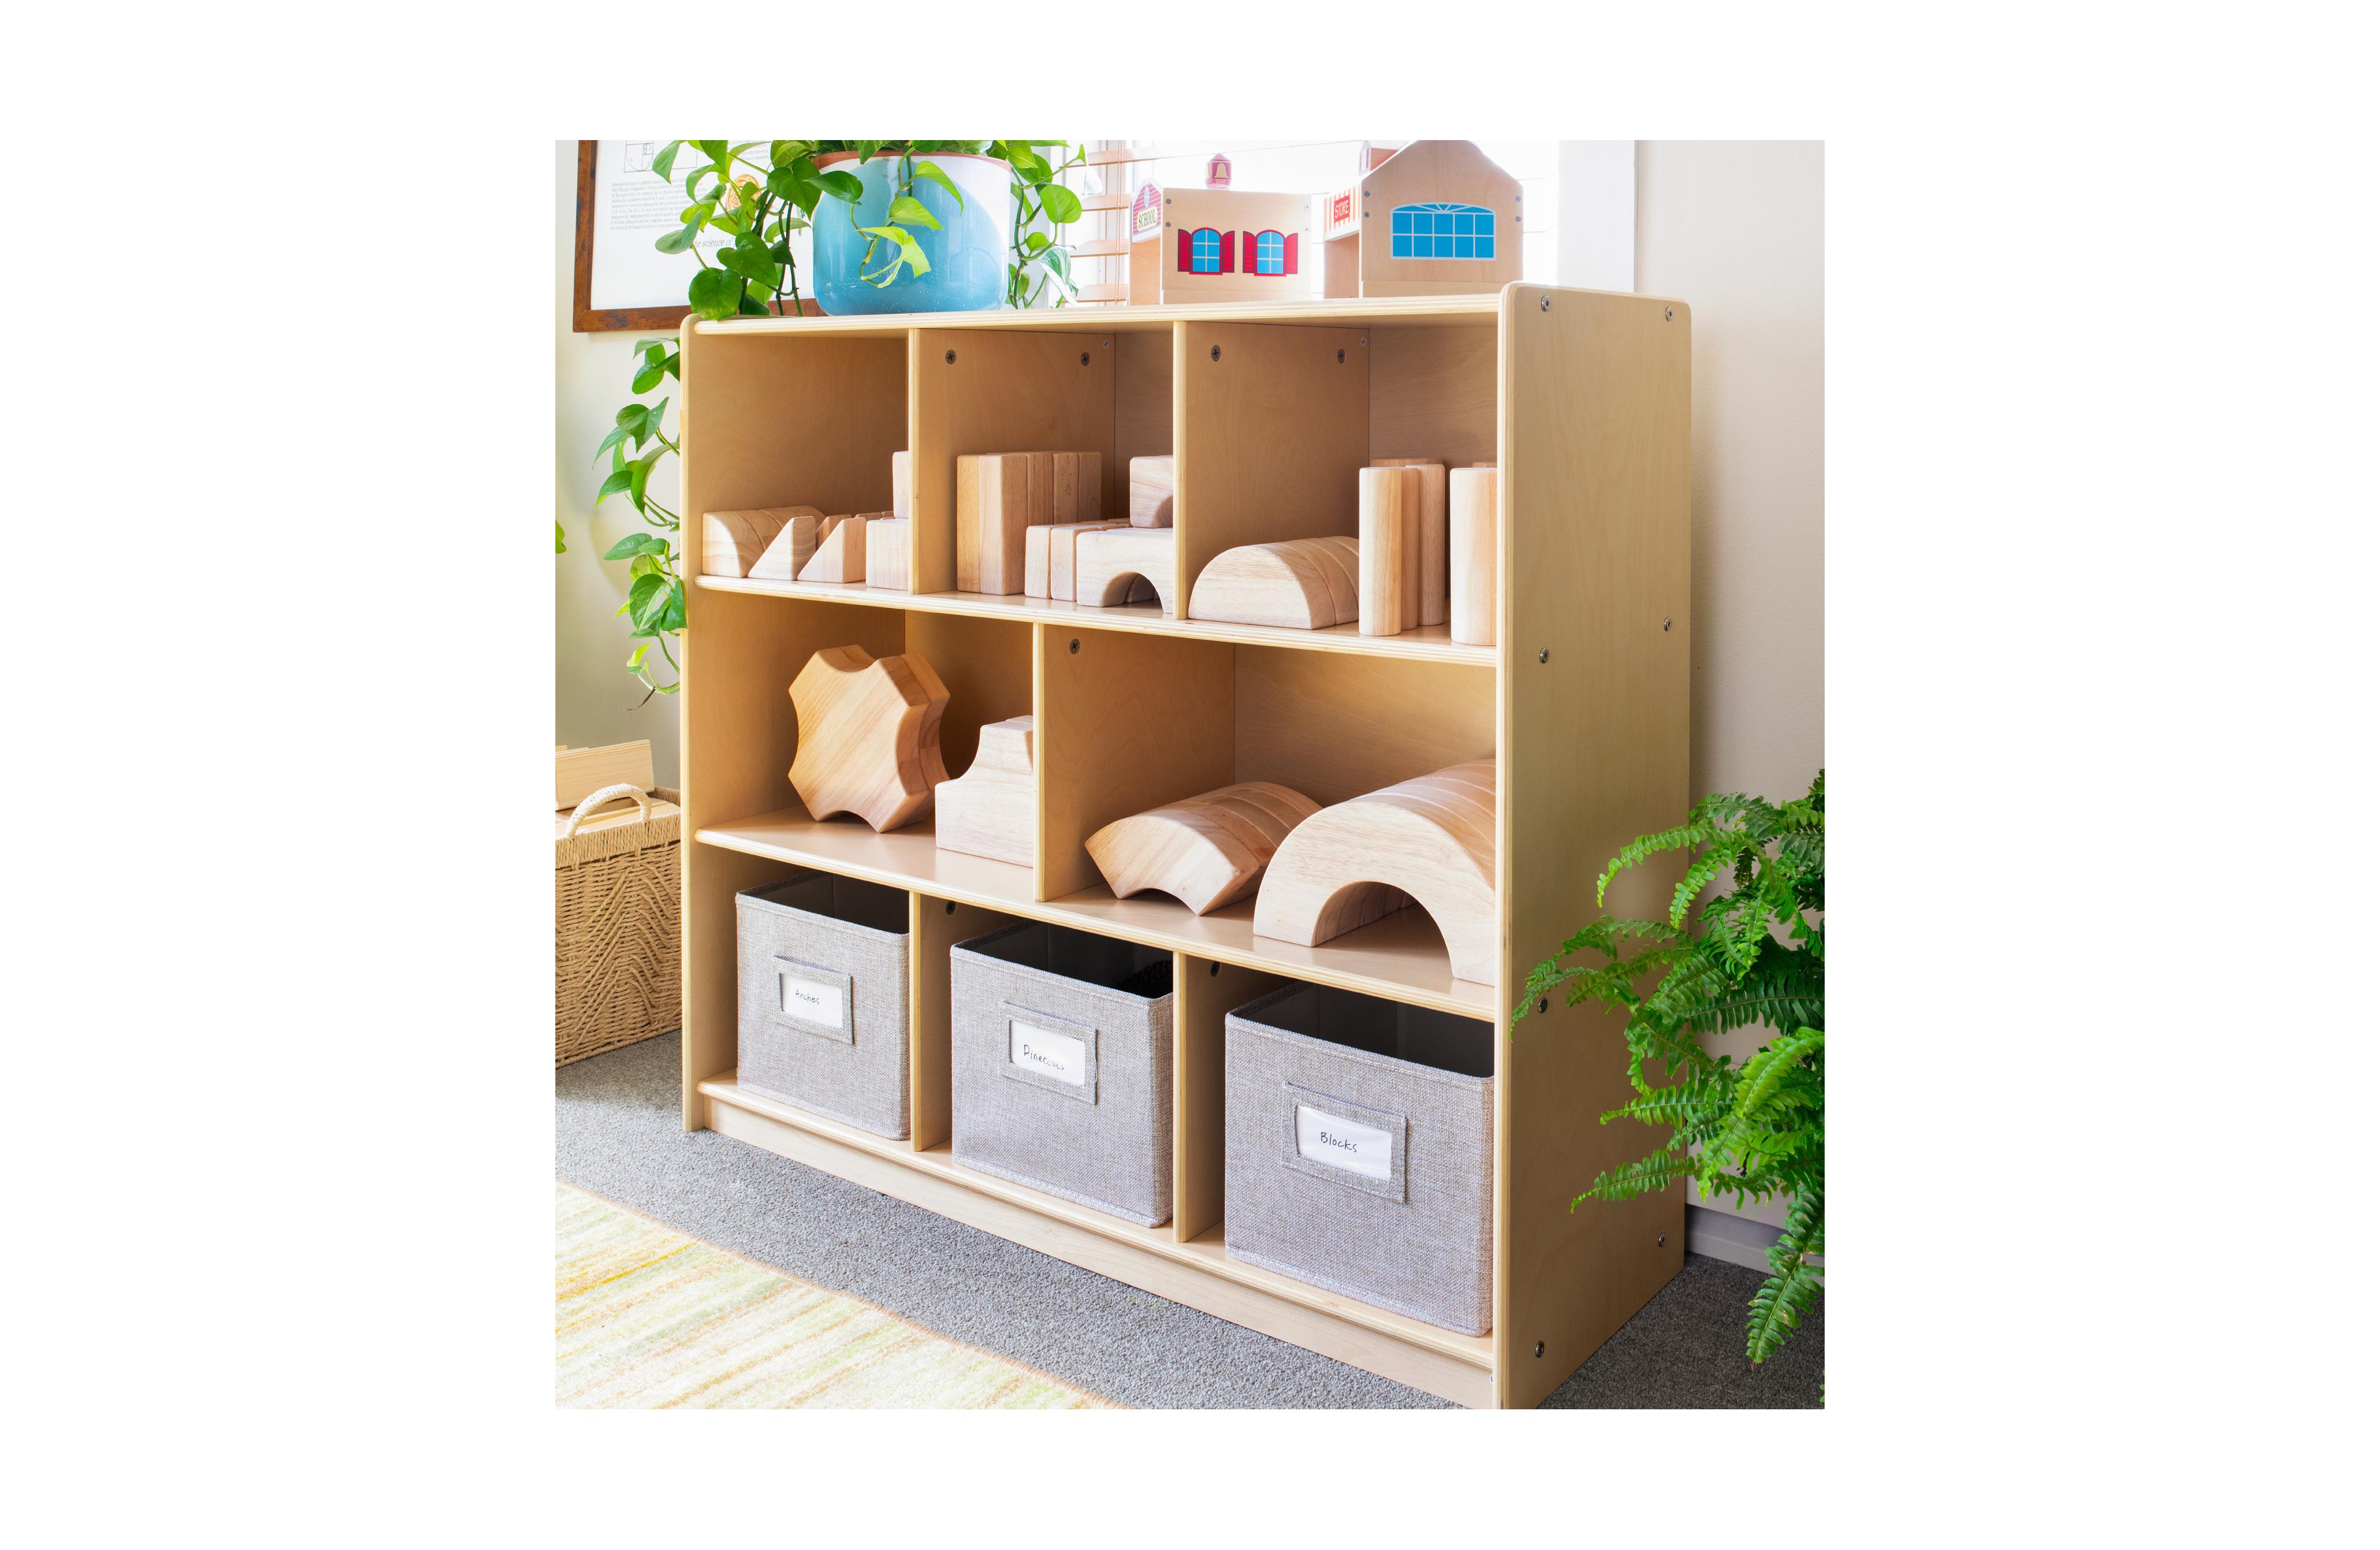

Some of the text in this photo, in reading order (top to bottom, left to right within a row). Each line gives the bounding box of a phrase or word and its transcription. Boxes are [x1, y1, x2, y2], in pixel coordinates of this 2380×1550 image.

[1138, 209, 1157, 229] SCHOOL
[1334, 199, 1349, 219] STORE
[702, 239, 725, 248] science
[726, 237, 734, 247] of
[795, 989, 820, 1005] Arches
[1023, 1044, 1065, 1071] Pinecones
[1320, 1132, 1357, 1153] Blocks
